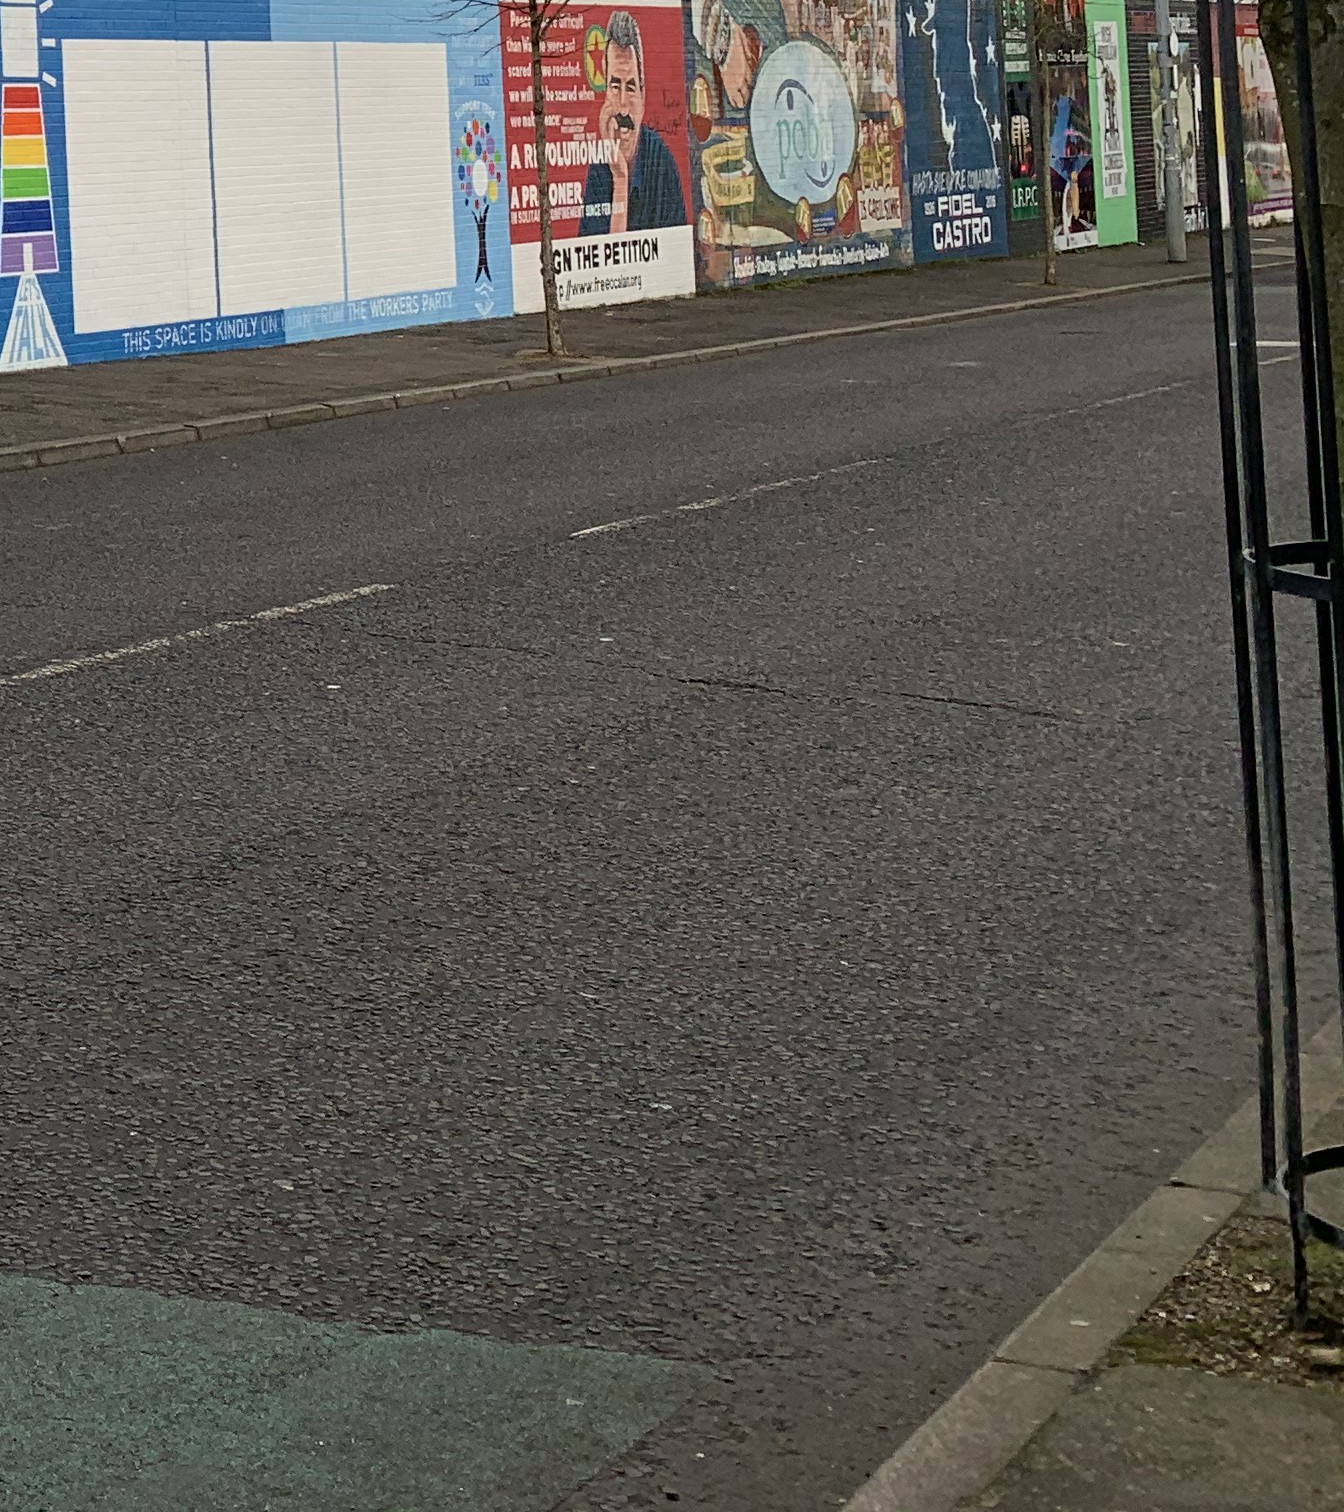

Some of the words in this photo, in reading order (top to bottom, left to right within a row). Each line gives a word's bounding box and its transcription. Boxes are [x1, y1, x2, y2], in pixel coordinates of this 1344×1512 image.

[508, 62, 531, 77] scared
[509, 90, 520, 102] we
[545, 84, 554, 101] be
[554, 84, 578, 102] scared
[510, 115, 522, 128] we
[510, 143, 522, 169] A
[510, 186, 520, 209] A
[521, 181, 584, 209] PRONER
[937, 193, 984, 218] FIDEL
[932, 216, 992, 251] CASTRO
[552, 246, 572, 275] GN
[574, 243, 599, 269] THE
[603, 237, 660, 267] PETITION
[9, 304, 61, 364] TALK
[122, 330, 151, 354] THIS
[154, 324, 197, 349] SPACE
[200, 322, 212, 343] IS
[215, 316, 258, 341] KINDLY
[261, 314, 278, 335] ON
[347, 301, 367, 321] THE
[369, 295, 419, 318] WORKERS
[421, 291, 453, 312] PARTY
